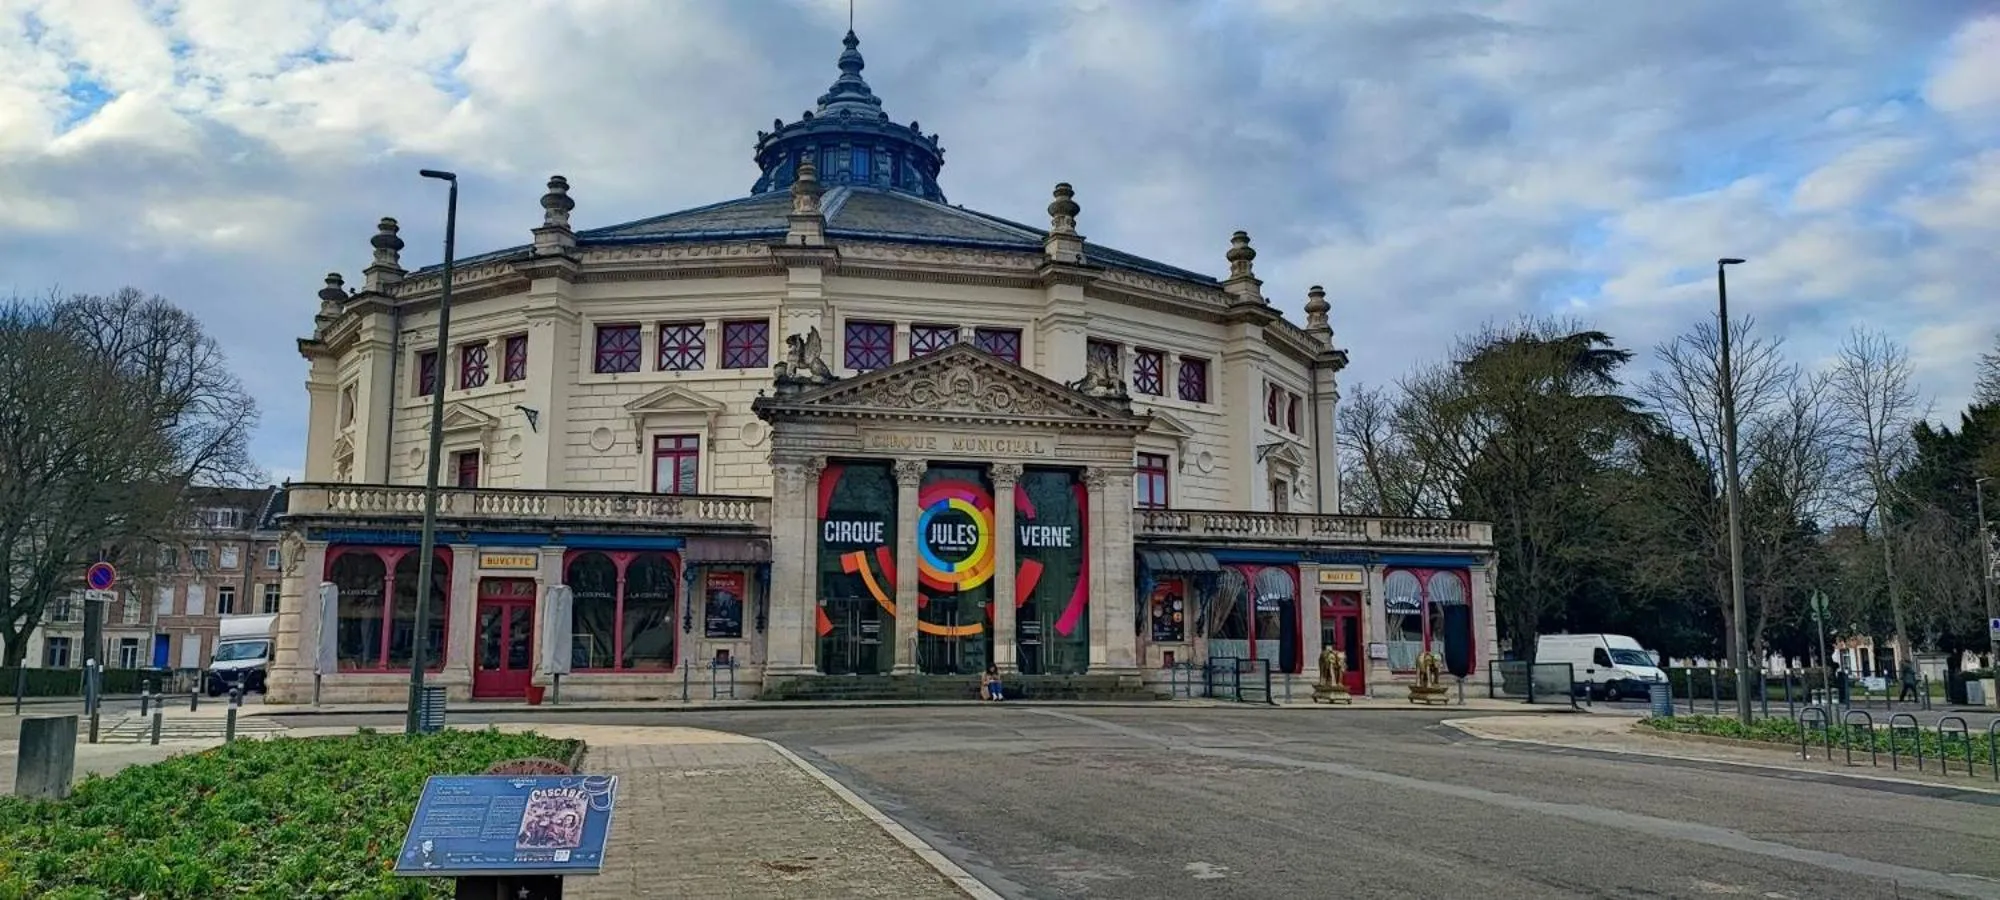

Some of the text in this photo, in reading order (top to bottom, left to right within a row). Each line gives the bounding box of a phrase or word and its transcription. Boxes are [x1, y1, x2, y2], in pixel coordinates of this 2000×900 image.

[872, 434, 1045, 454] CIRQUE MUNICIPAL
[824, 520, 885, 544] CIRQUE
[929, 523, 978, 545] JULES
[1020, 525, 1072, 548] VERNE
[487, 556, 532, 566] BUVETTE
